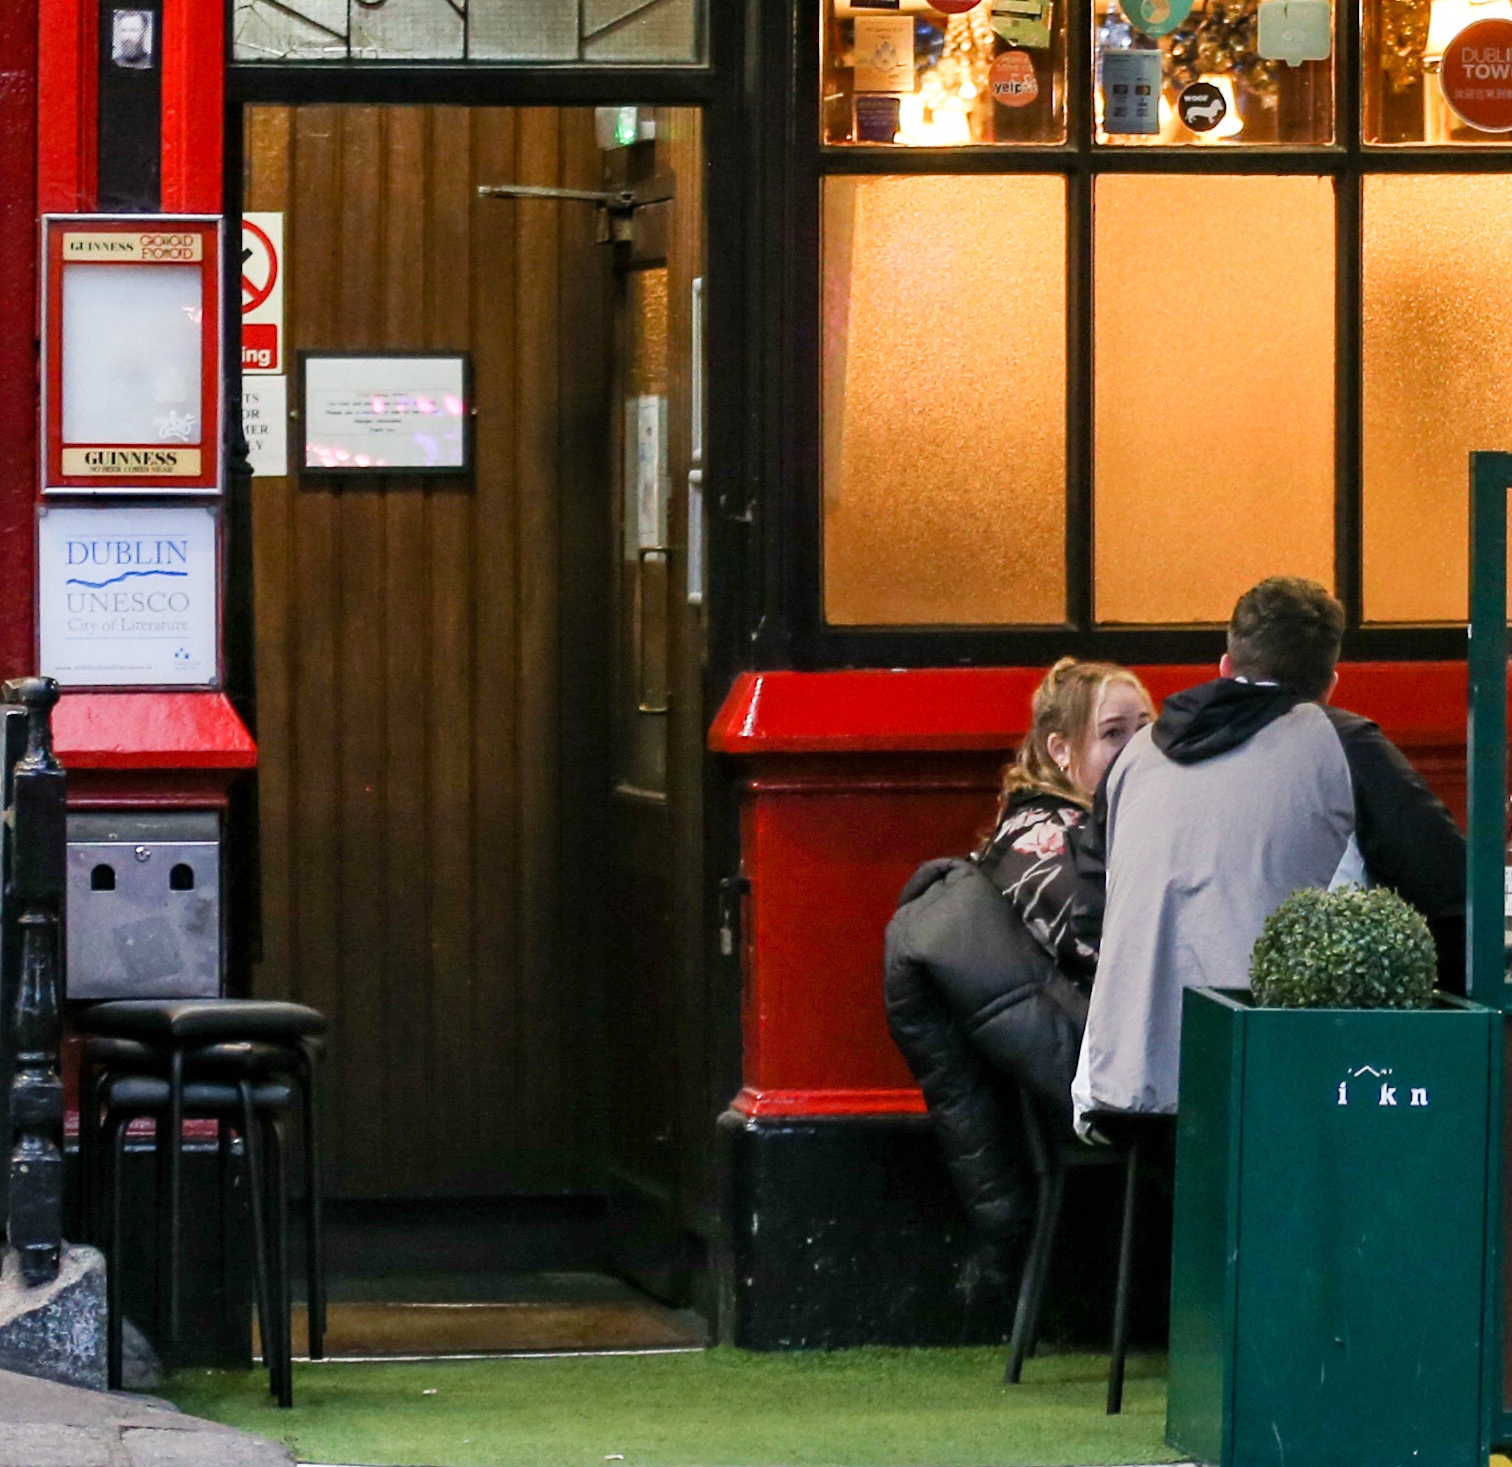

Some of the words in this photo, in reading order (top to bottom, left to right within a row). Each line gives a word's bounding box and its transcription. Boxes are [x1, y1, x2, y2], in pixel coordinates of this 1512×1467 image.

[994, 81, 1024, 95] yelp
[70, 241, 134, 252] GUINNESS
[84, 451, 178, 467] GUINNESS
[65, 540, 189, 566] DUBLIN
[65, 591, 190, 614] UNESCO
[67, 617, 97, 635] City
[102, 617, 115, 632] of
[121, 617, 189, 632] Literature
